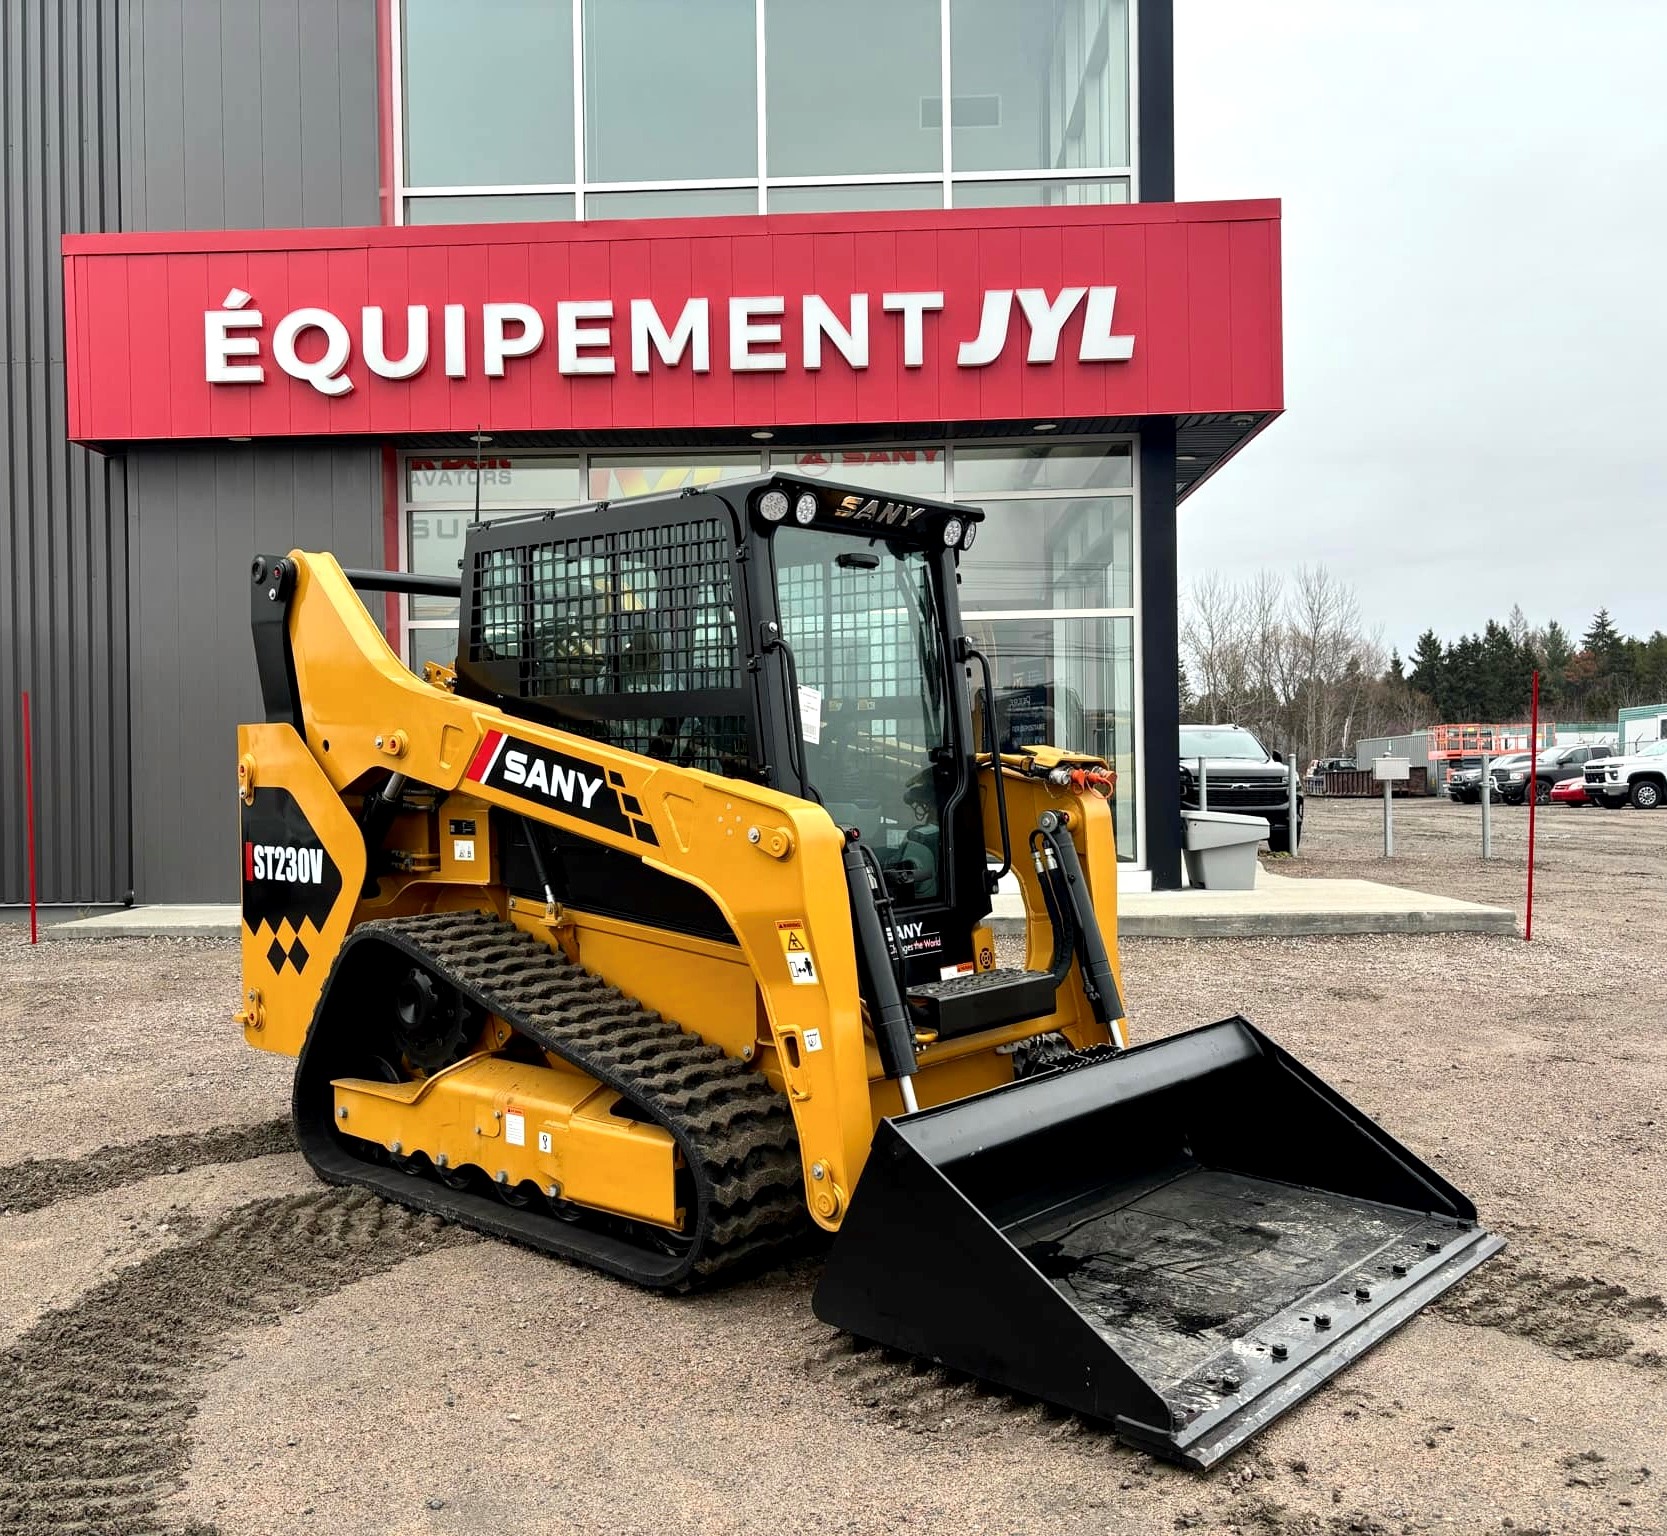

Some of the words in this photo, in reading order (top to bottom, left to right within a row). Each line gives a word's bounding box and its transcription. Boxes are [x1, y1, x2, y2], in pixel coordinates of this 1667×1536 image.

[204, 288, 945, 396] ÉQUIPEMENT
[957, 286, 1136, 367] JYL
[841, 450, 938, 467] SANY
[835, 495, 926, 527] SANY
[412, 518, 472, 540] SU
[503, 750, 604, 809] SANY
[253, 844, 324, 885] ST230V
[923, 935, 942, 948] World
